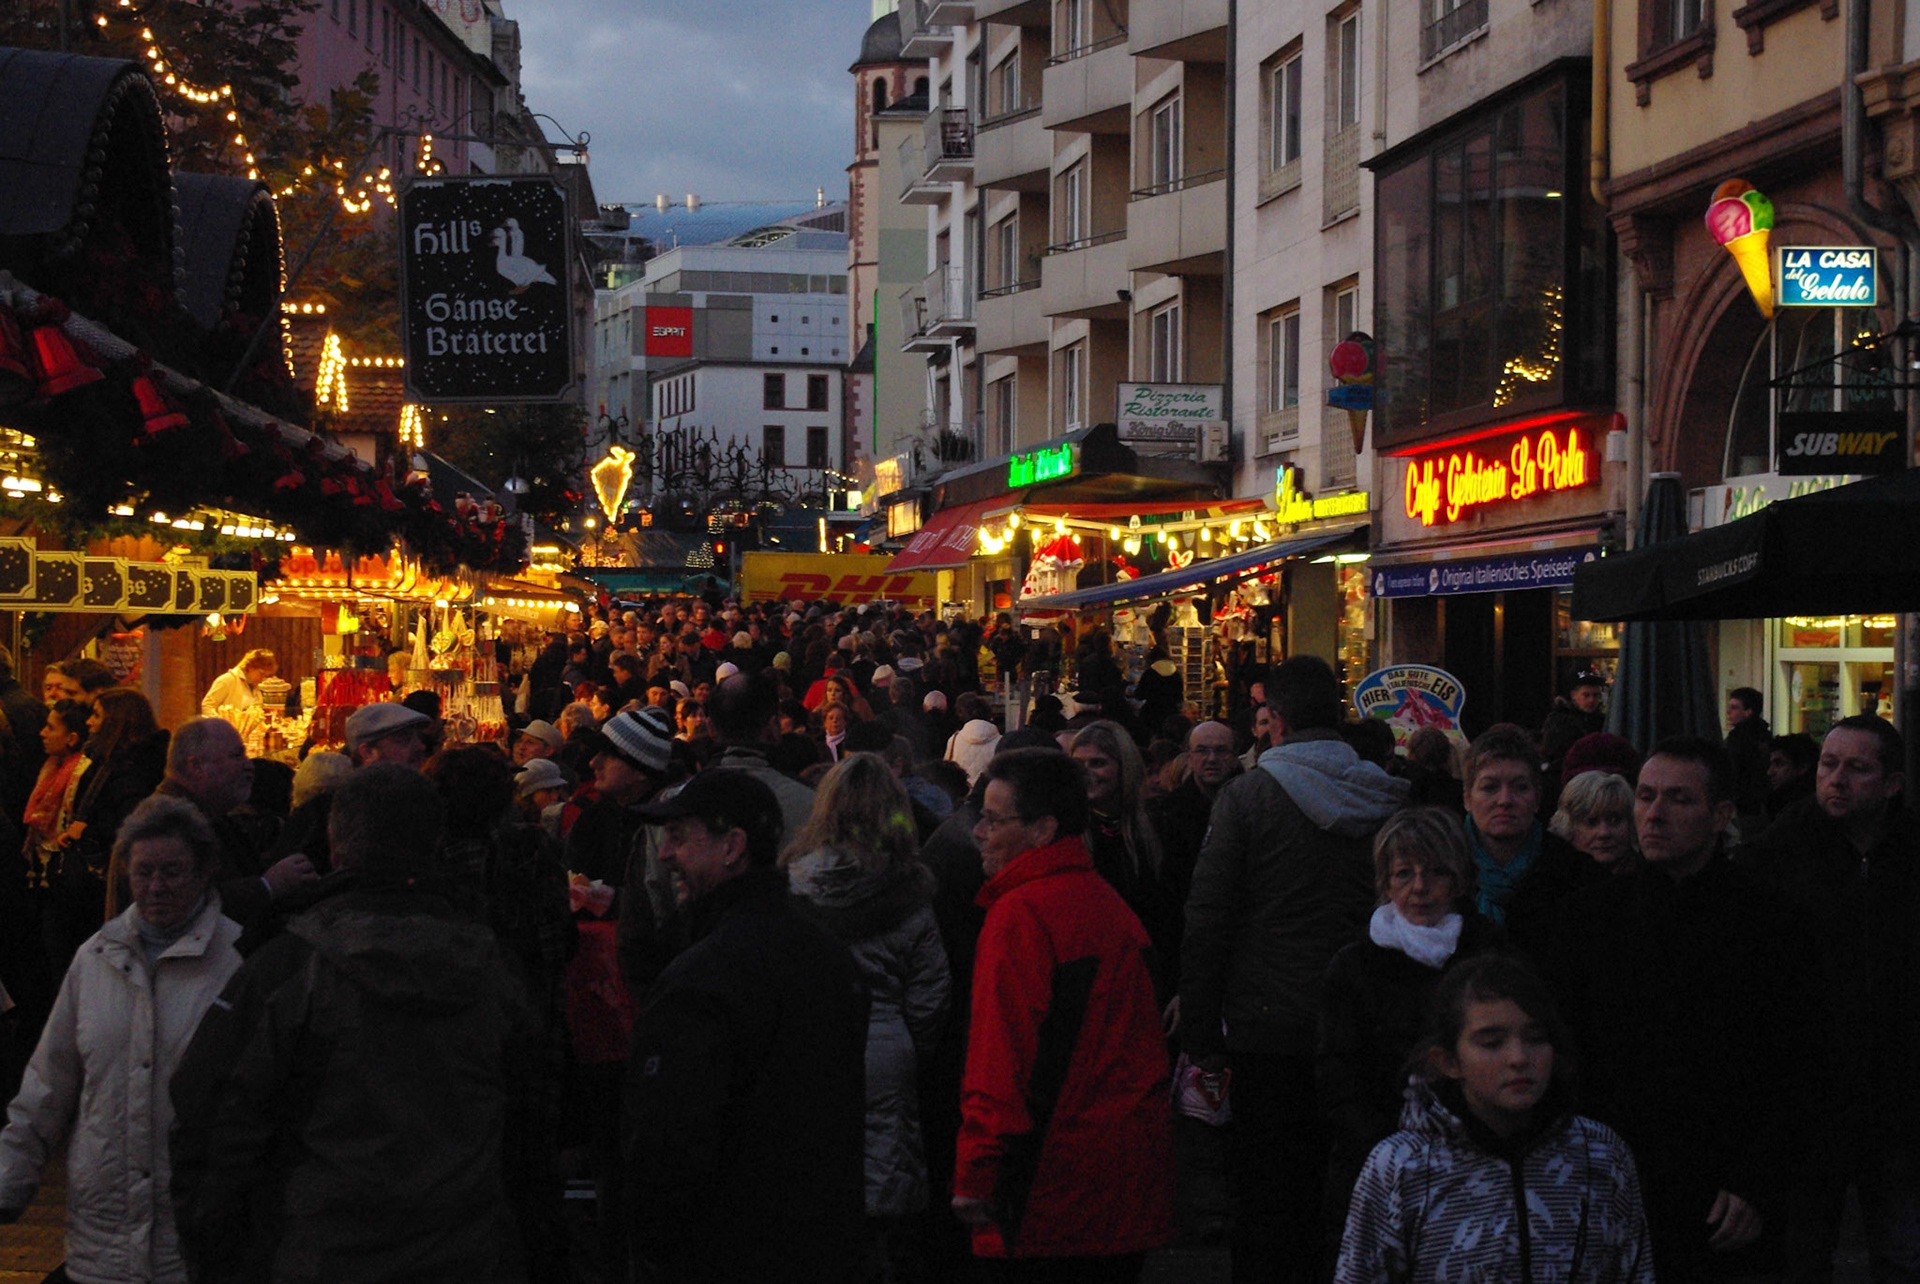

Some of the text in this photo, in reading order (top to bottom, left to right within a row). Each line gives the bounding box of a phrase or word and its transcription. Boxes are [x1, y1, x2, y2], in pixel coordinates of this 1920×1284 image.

[1785, 251, 1871, 269] LA CASA
[1785, 268, 1804, 280] del
[1798, 273, 1870, 301] Gelato
[425, 292, 529, 323] Gänse-
[652, 326, 686, 337] ESPRIT
[1134, 387, 1207, 407] Pizzeria
[1123, 402, 1215, 418] Ristorante
[1785, 431, 1898, 456] SUBWAY
[1446, 450, 1507, 523] Gelateria
[1510, 435, 1537, 500] La
[1537, 427, 1586, 491] Perla
[1441, 566, 1475, 591] Original
[1475, 562, 1530, 585] italienisches
[776, 572, 921, 604] DHL
[1387, 670, 1430, 680] DAS GUTE
[1361, 688, 1391, 709] HIER
[1431, 677, 1456, 701] EIS
